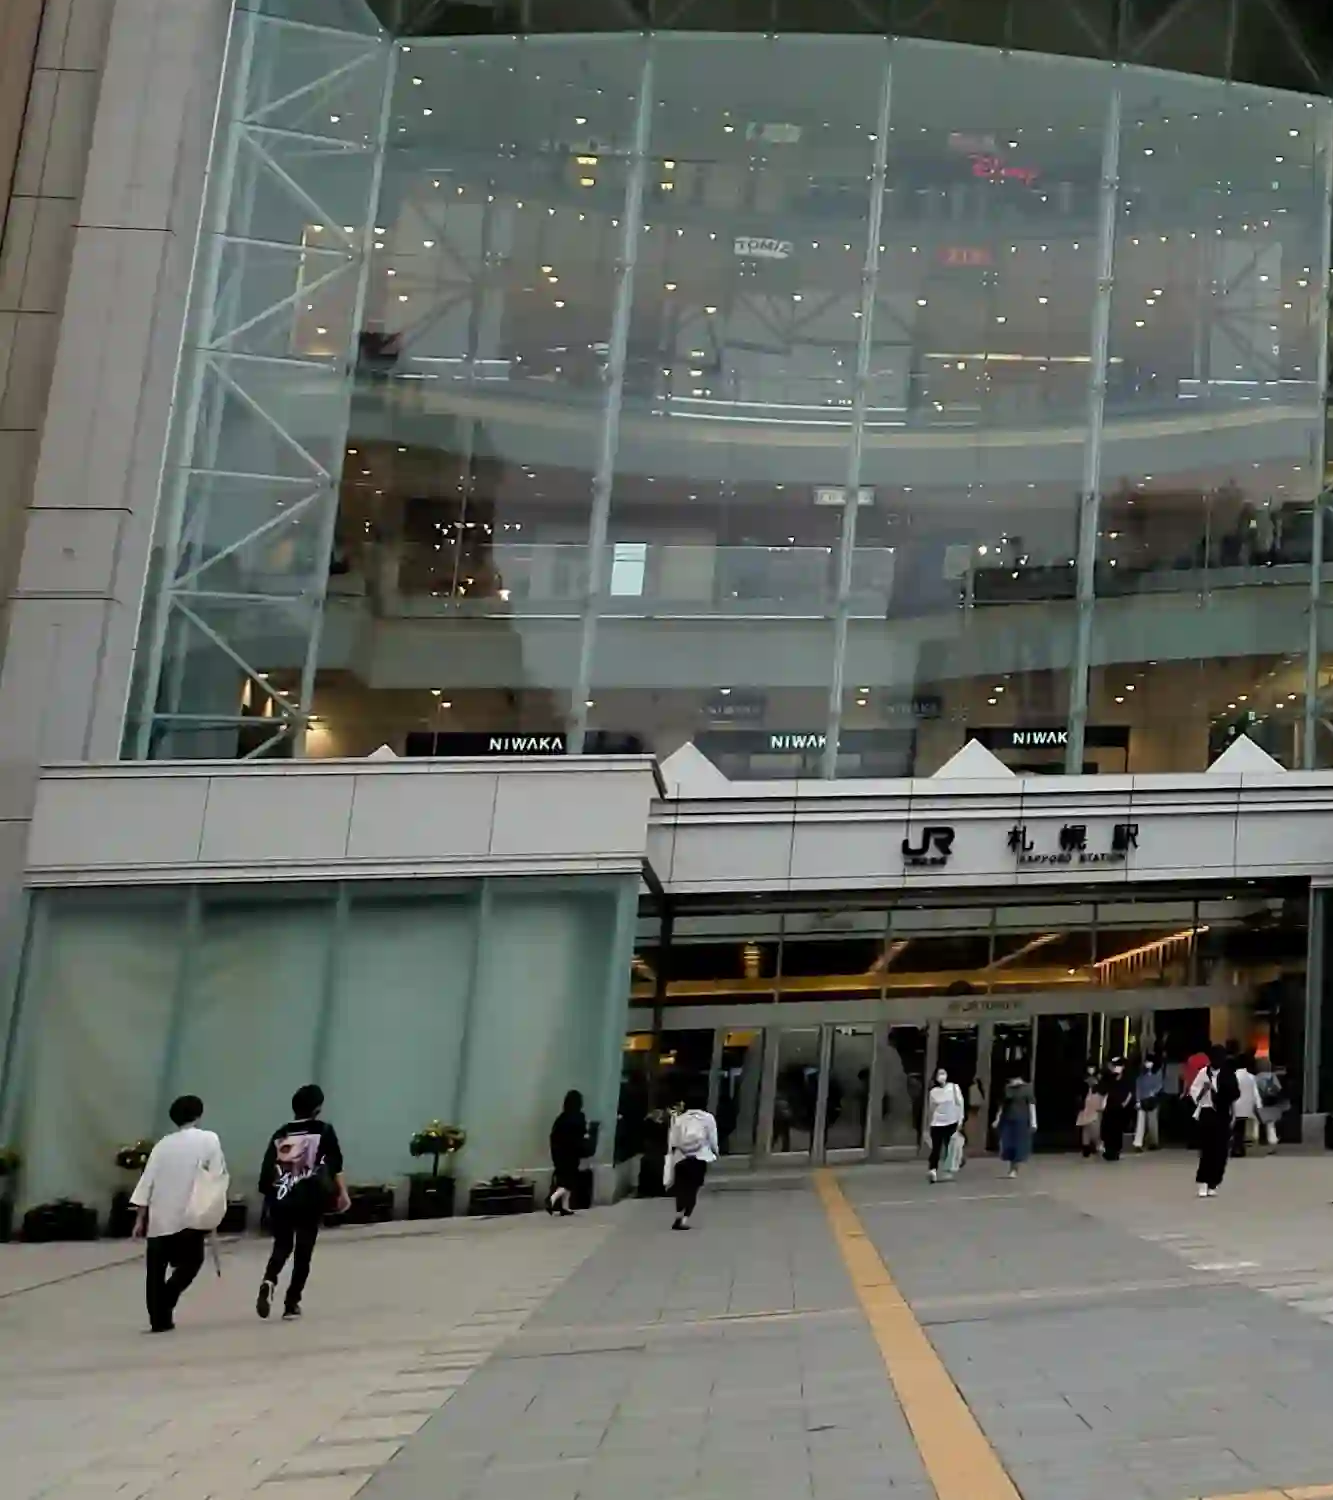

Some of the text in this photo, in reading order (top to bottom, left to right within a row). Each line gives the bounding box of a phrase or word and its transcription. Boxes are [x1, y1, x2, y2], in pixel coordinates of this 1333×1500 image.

[488, 736, 564, 751] NIWAKA
[771, 734, 840, 749] NIWAK
[1012, 731, 1068, 745] NIWAK
[901, 826, 956, 856] JR
